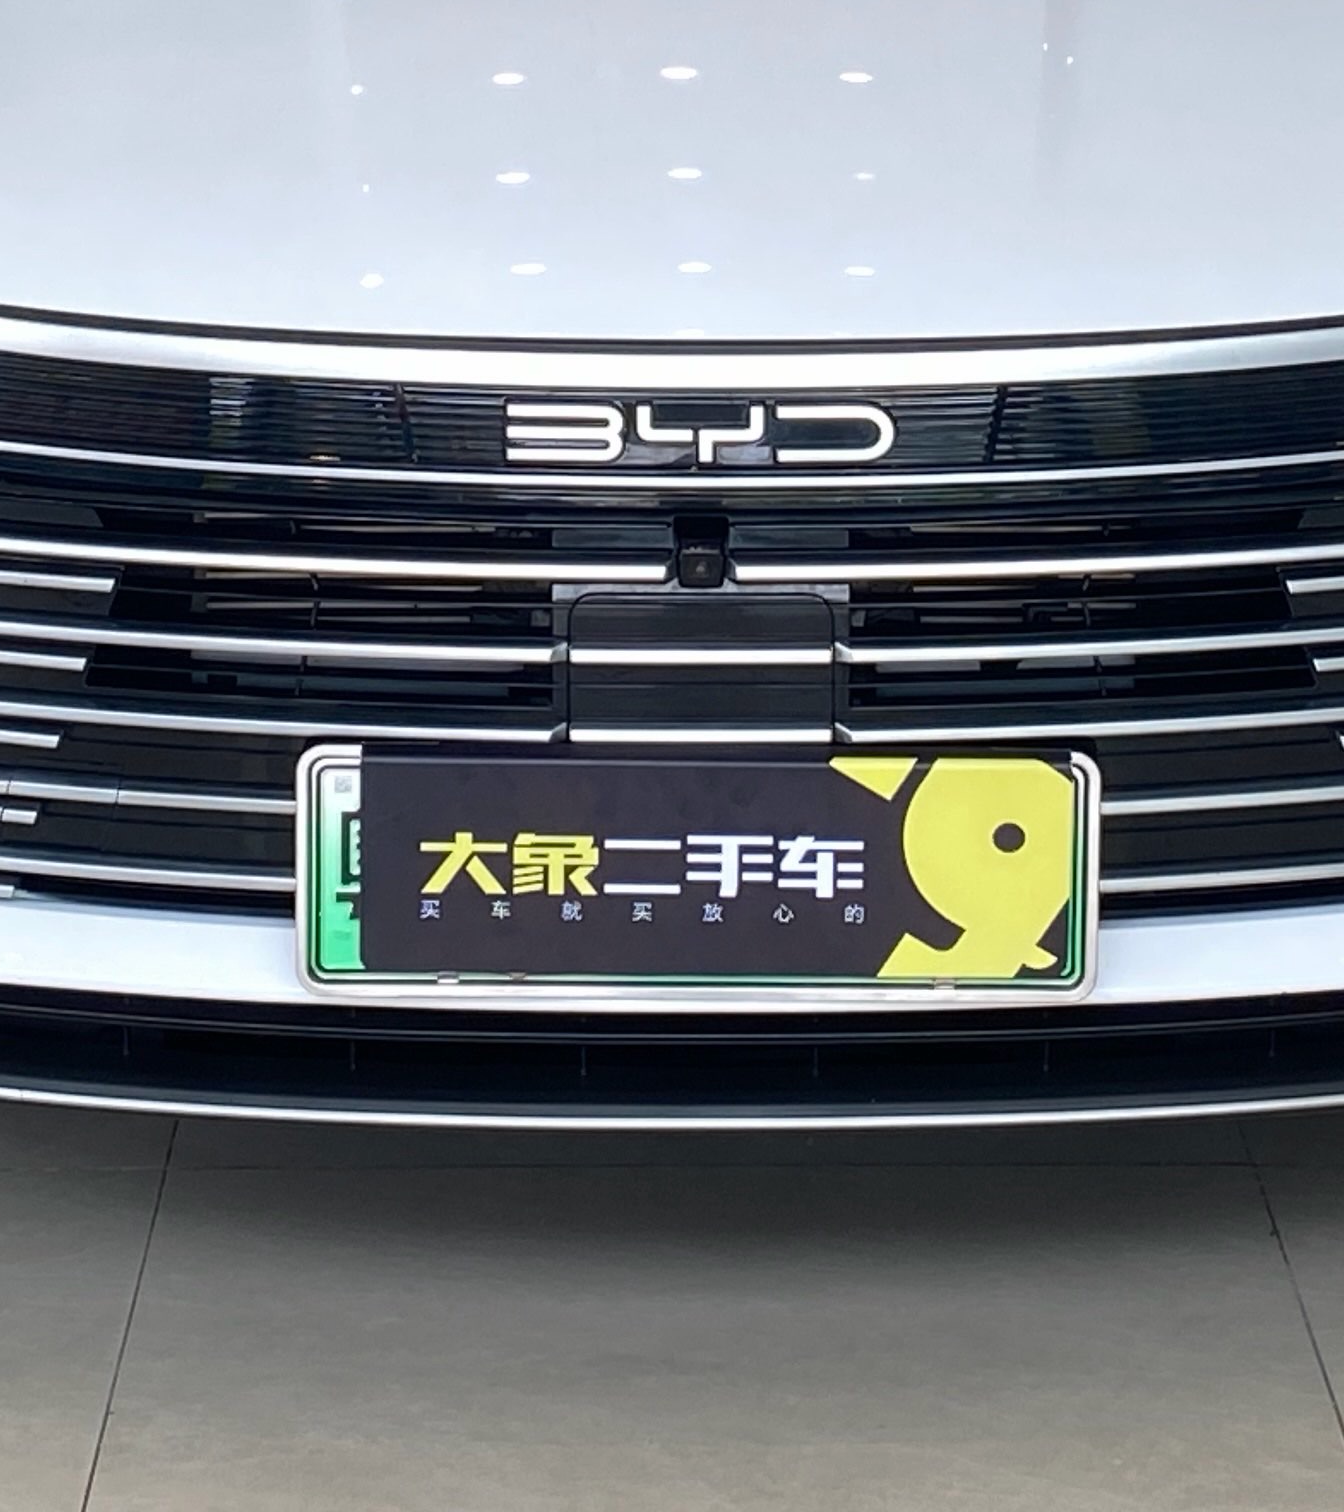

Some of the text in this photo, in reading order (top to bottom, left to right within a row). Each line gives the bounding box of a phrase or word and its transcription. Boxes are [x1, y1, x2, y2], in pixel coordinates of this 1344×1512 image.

[506, 404, 895, 463] BYD
[419, 831, 865, 899] 大象二手车
[419, 899, 865, 924] 买车就买放心的
